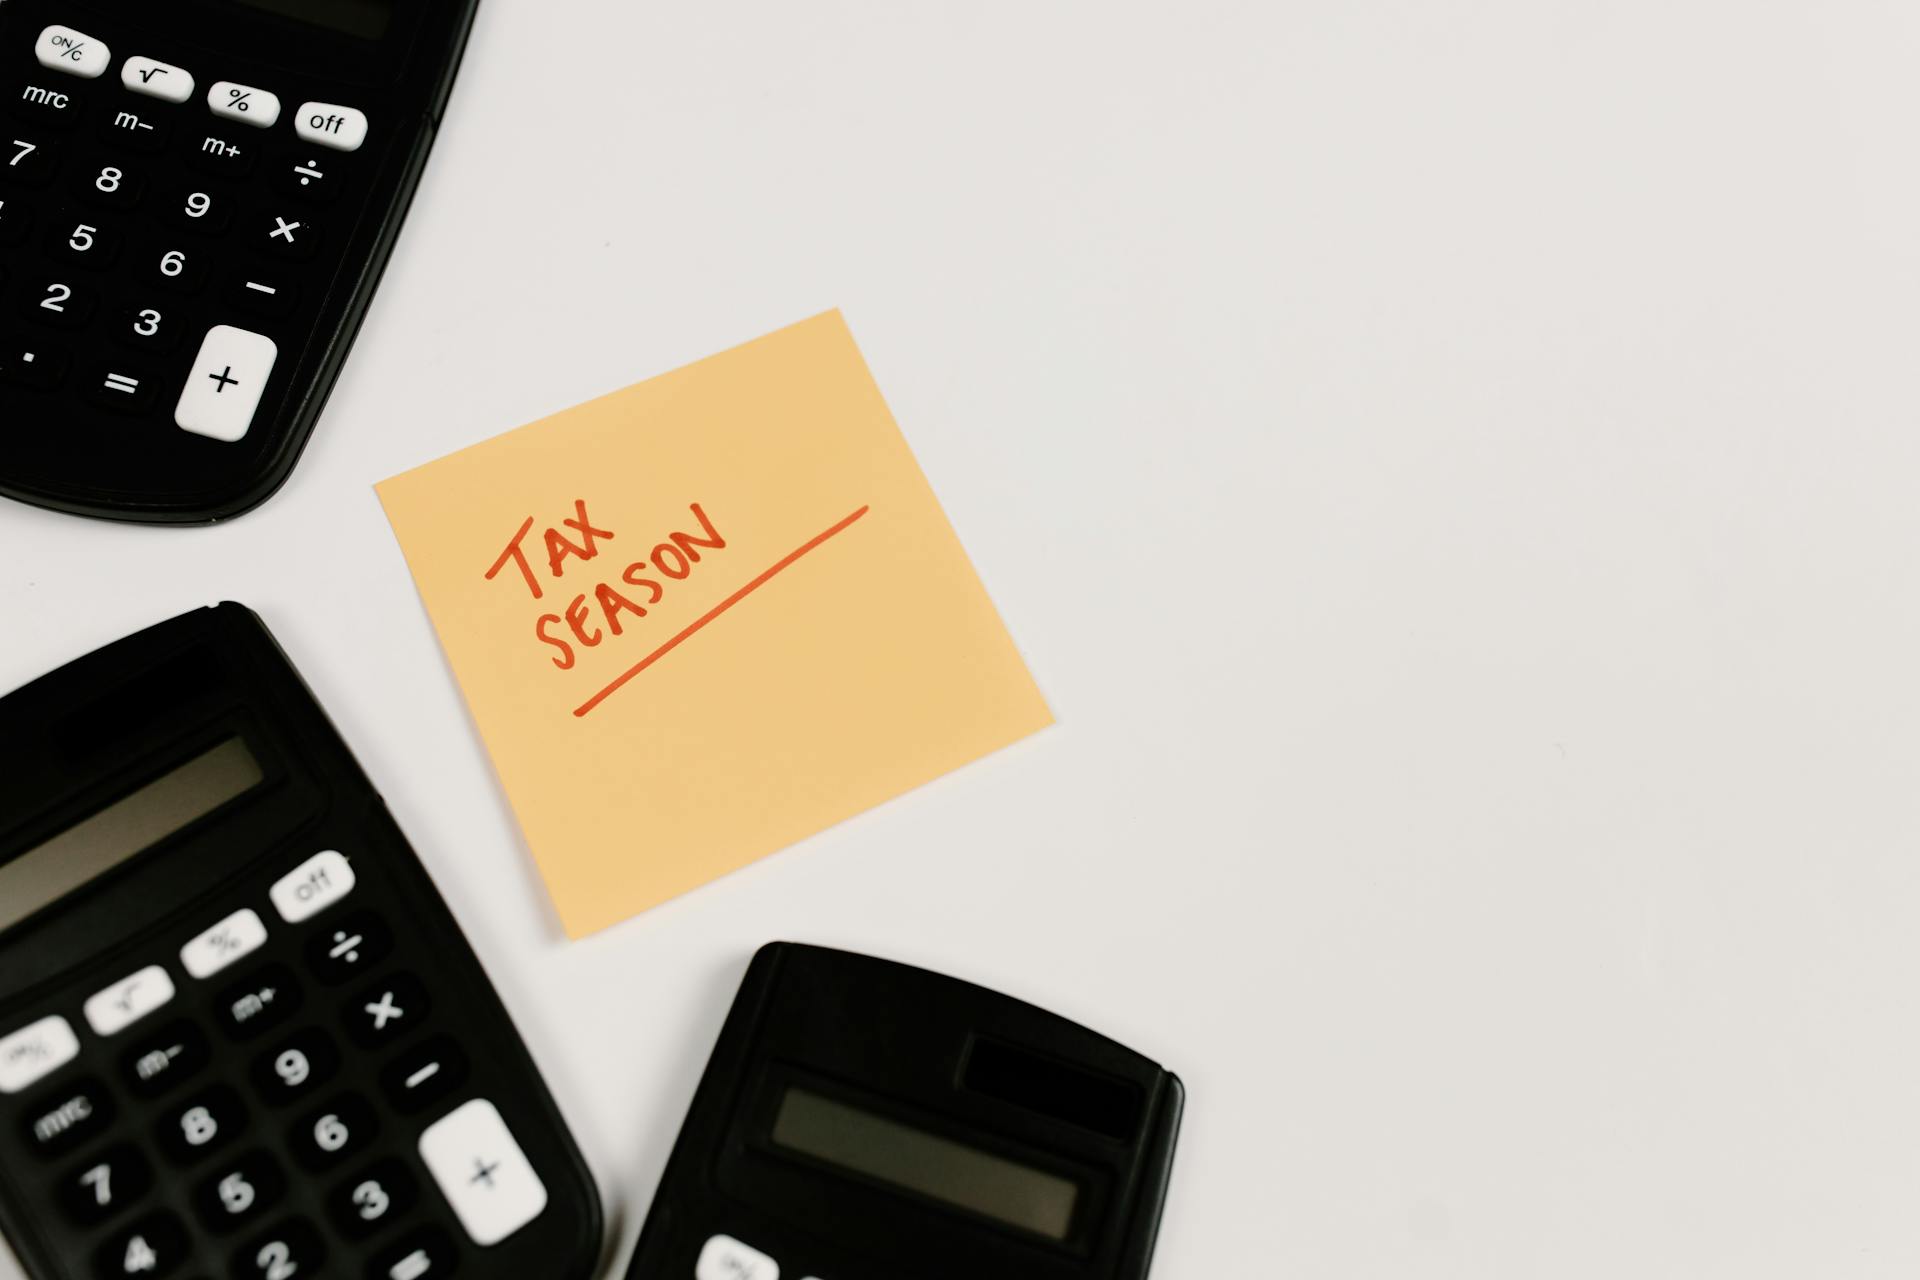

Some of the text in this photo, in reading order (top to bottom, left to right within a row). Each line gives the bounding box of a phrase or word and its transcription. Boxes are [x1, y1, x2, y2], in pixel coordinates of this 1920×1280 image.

[52, 35, 83, 62] ON/C
[22, 85, 69, 110] mrc
[310, 114, 345, 135] off
[9, 140, 36, 166] 7
[202, 136, 241, 158] m+
[95, 167, 122, 192] 8
[185, 193, 210, 218] 9
[69, 224, 97, 251] 5
[160, 250, 186, 276] 6
[40, 284, 71, 312] 2
[133, 309, 162, 336] 3
[485, 499, 615, 600] TAX
[535, 502, 727, 670] SEASON
[293, 867, 331, 901] off
[274, 1048, 310, 1087] 9
[180, 1105, 218, 1146] 8
[313, 1113, 349, 1152] 6
[80, 1163, 112, 1206] 7
[218, 1172, 256, 1214] 5
[352, 1179, 390, 1221] 3
[256, 1240, 298, 1280] 2
